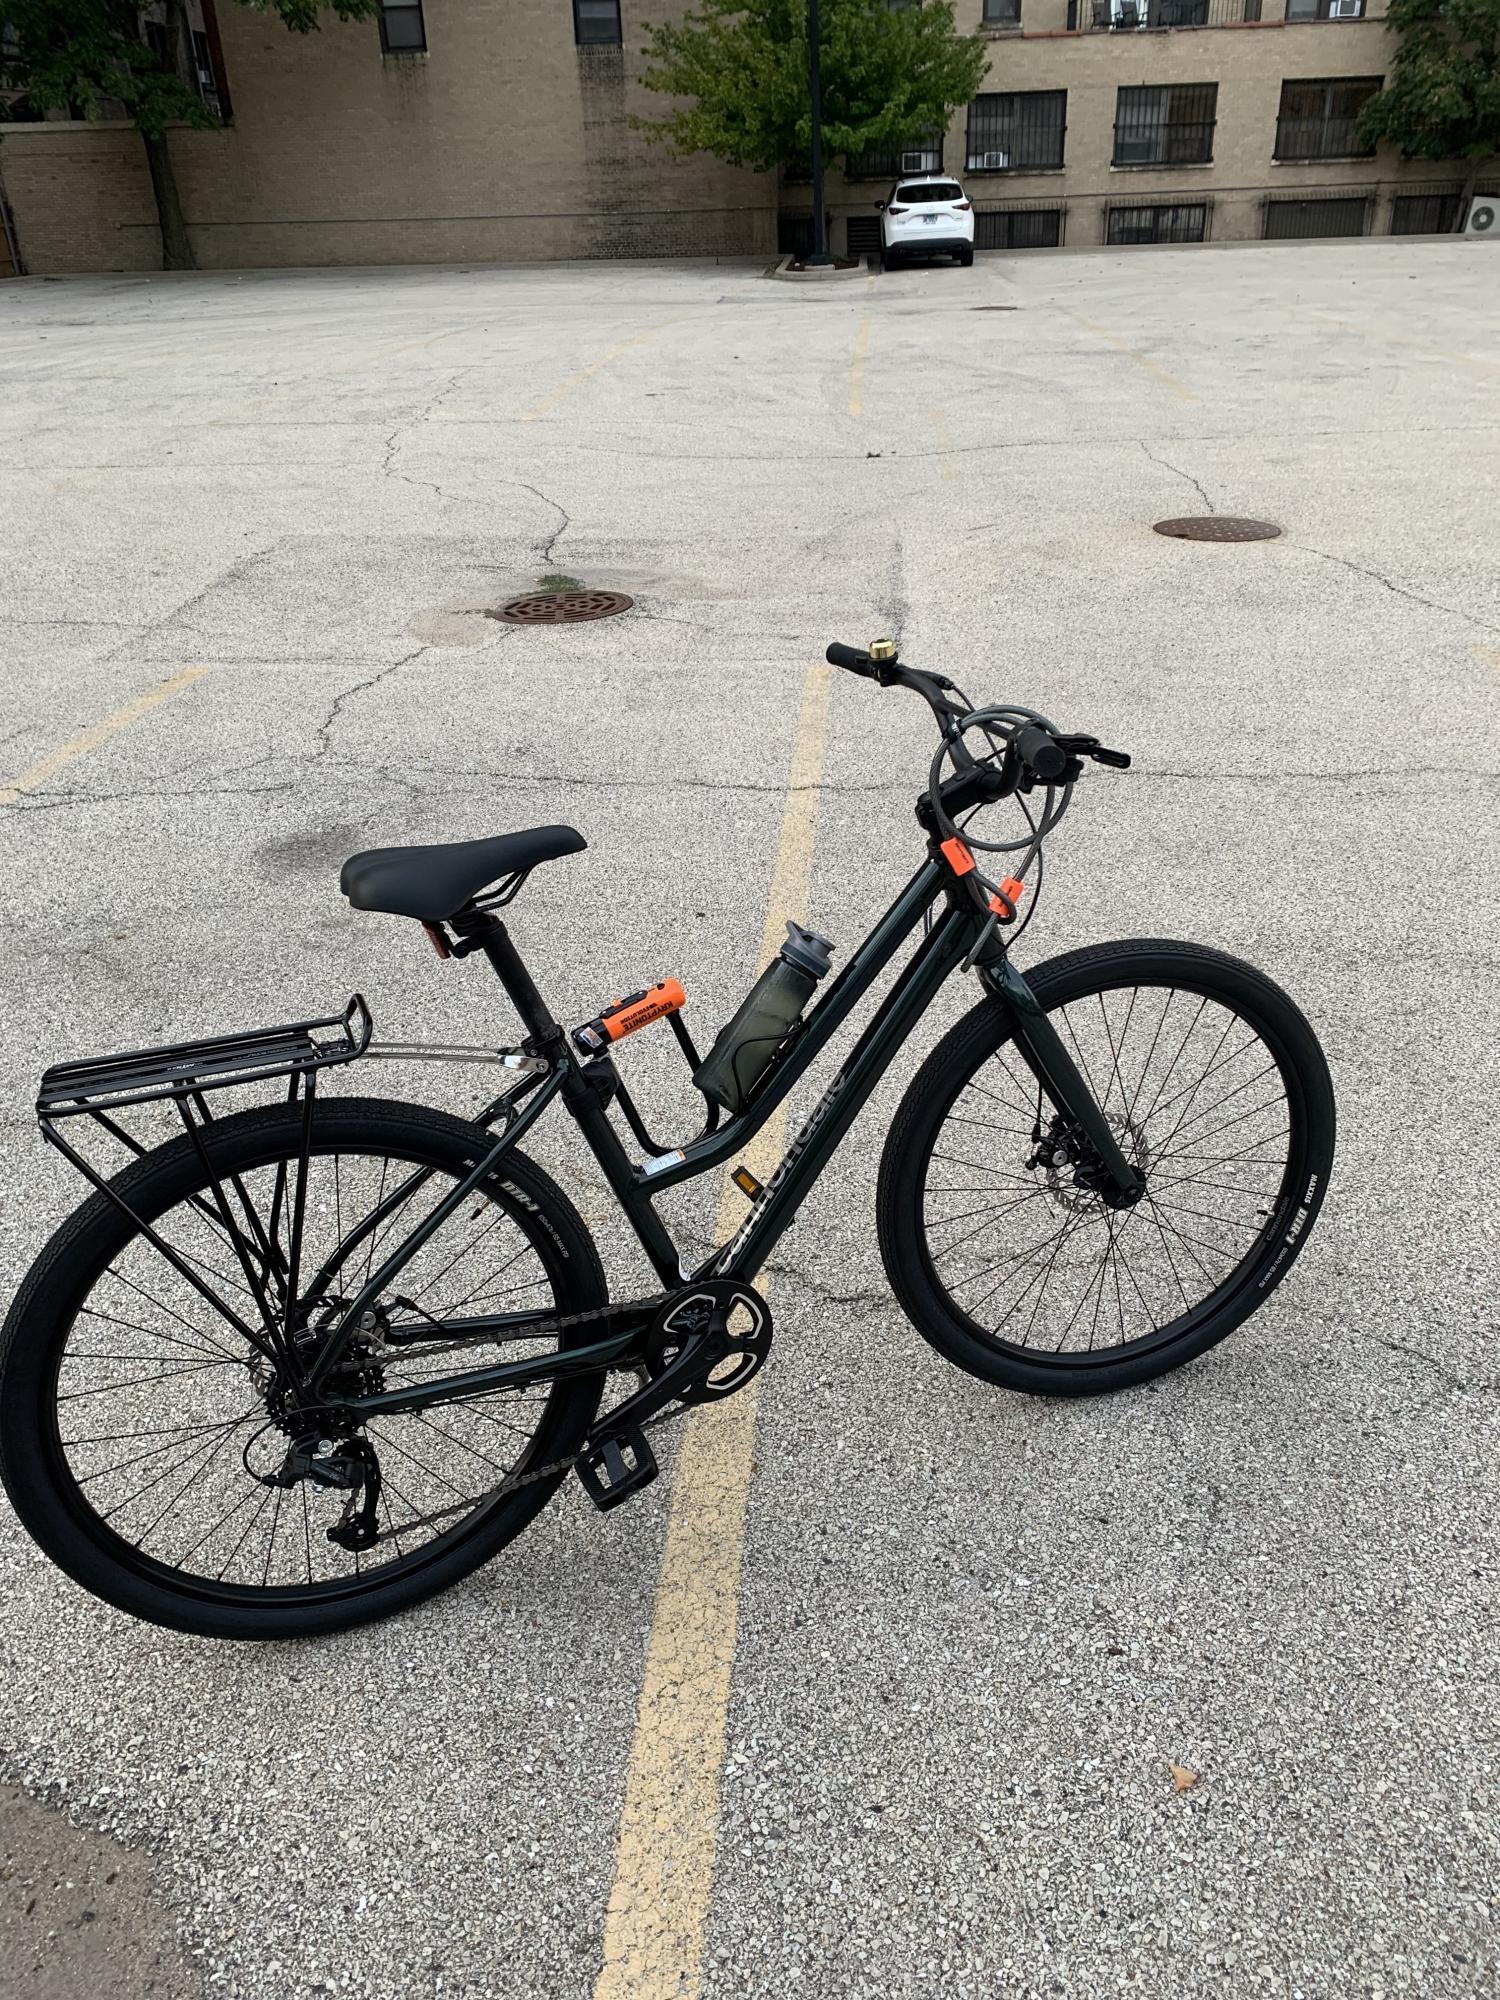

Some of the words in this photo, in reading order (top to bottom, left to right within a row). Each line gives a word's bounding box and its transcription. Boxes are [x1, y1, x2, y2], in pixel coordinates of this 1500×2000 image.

[621, 1001, 674, 1031] KRYPTONITE
[1304, 1173, 1318, 1204] MAXXIS
[1285, 1206, 1309, 1245] DTR-1
